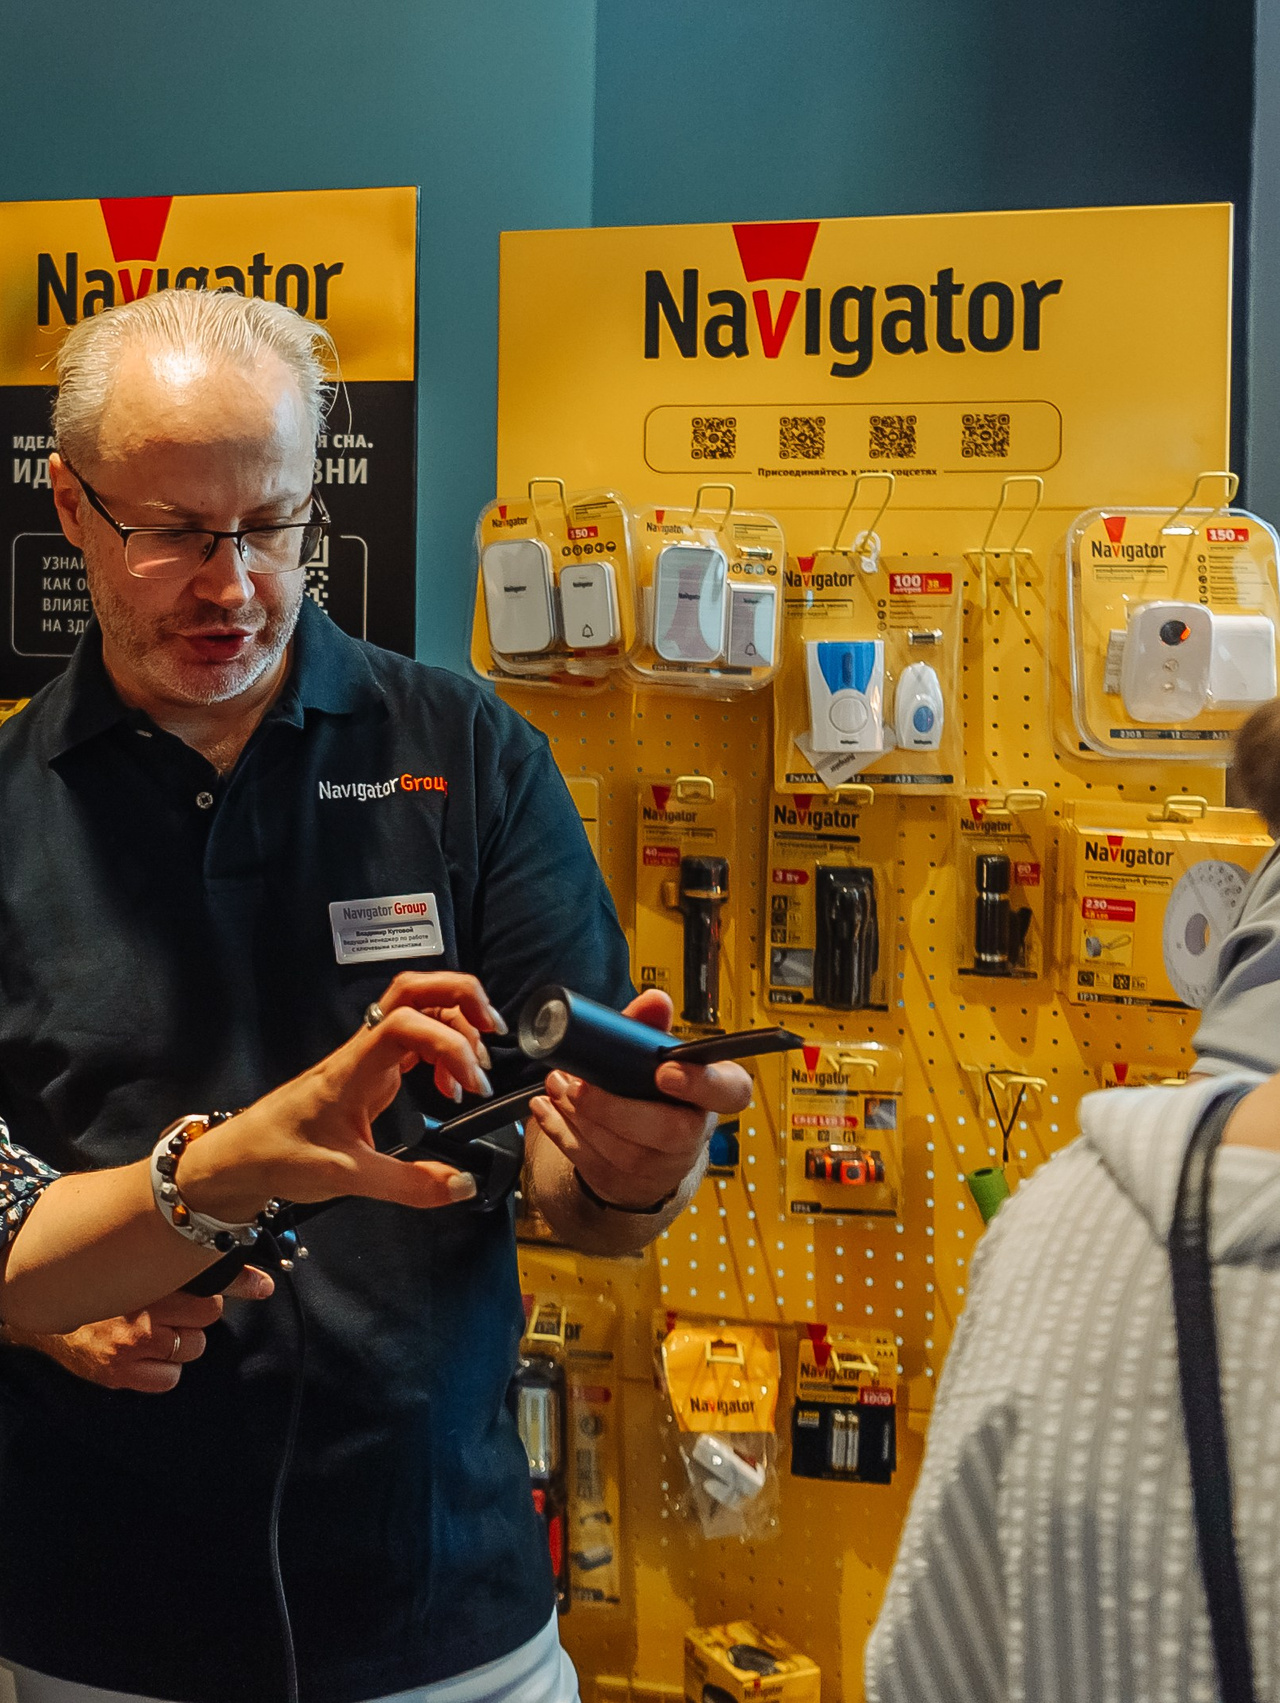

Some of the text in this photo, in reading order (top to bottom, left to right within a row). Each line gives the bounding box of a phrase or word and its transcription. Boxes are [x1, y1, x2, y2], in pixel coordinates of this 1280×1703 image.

[38, 252, 344, 326] Navtor
[644, 267, 1064, 378] Navigator
[13, 435, 56, 451] ИДЕА
[333, 434, 374, 448] СНА.
[13, 458, 52, 489] ИД
[313, 457, 368, 485] ЗНИ
[757, 467, 848, 478] Присоединяйтесь
[891, 468, 937, 478] соцсетях
[1209, 529, 1236, 541] 150
[1091, 540, 1167, 562] Navigator
[43, 577, 72, 591] КАК
[783, 570, 856, 591] Navigator
[893, 574, 922, 587] 100
[42, 598, 90, 612] ВЛИЯЕ
[42, 618, 62, 632] НА
[319, 778, 399, 802] Navigator
[774, 804, 860, 831] Navigator
[1084, 841, 1174, 868] Navigator
[343, 902, 427, 920] Navigator Group
[690, 1397, 755, 1416] Navigator
